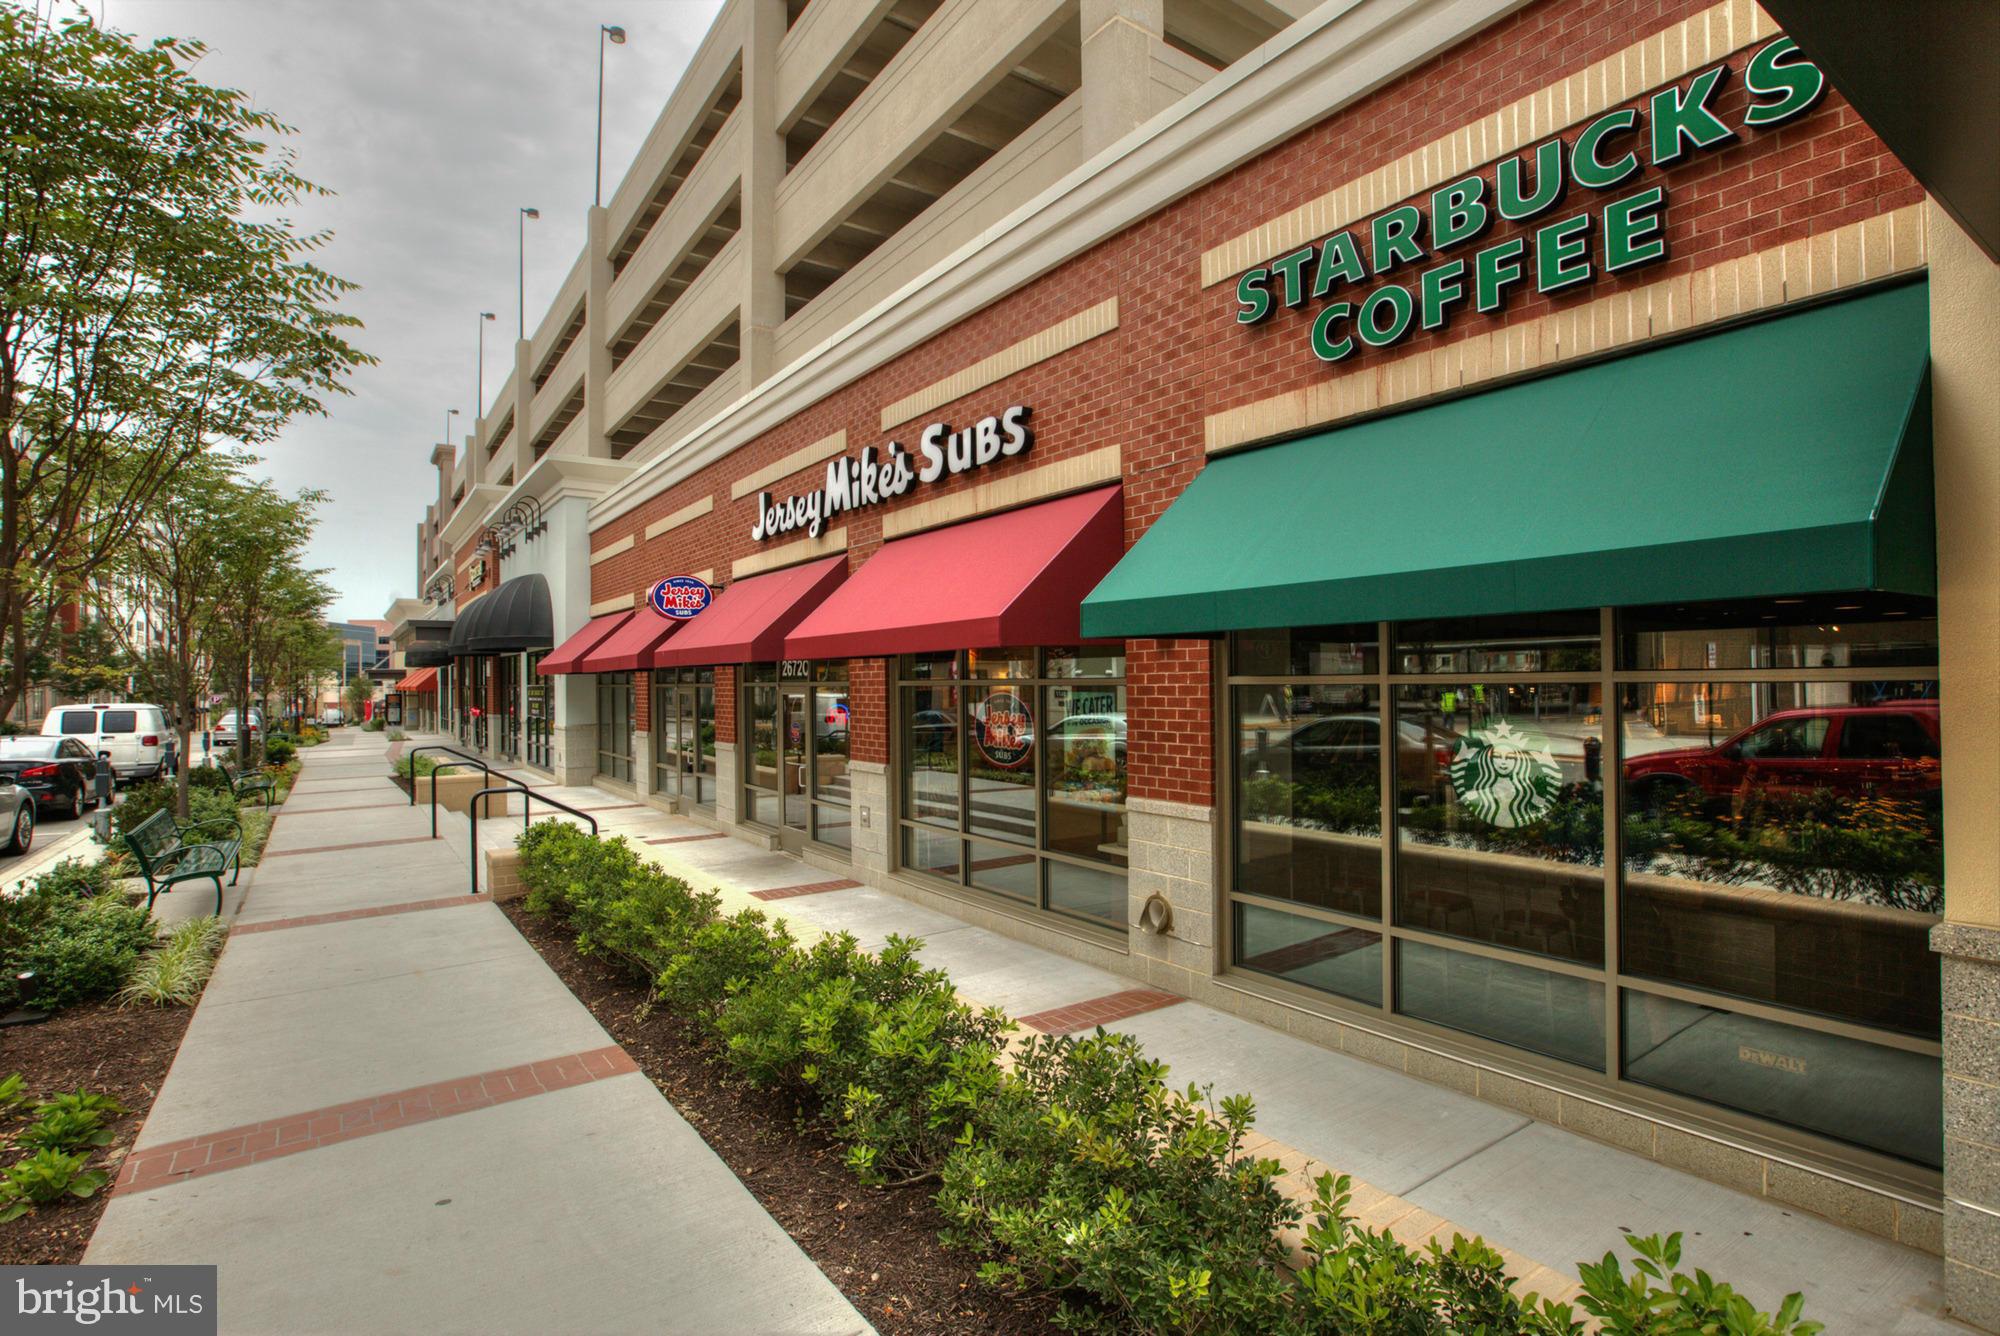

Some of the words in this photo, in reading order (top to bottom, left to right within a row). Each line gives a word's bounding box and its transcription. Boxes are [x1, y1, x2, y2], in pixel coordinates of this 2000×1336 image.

[1236, 36, 1826, 324] STARBUCKS
[1310, 186, 1669, 363] COFFEE
[752, 490, 823, 541] Jersey
[824, 441, 914, 518] Mike's
[661, 583, 705, 599] Jersey
[1082, 695, 1113, 715] CATER
[995, 750, 1012, 760] SUBS
